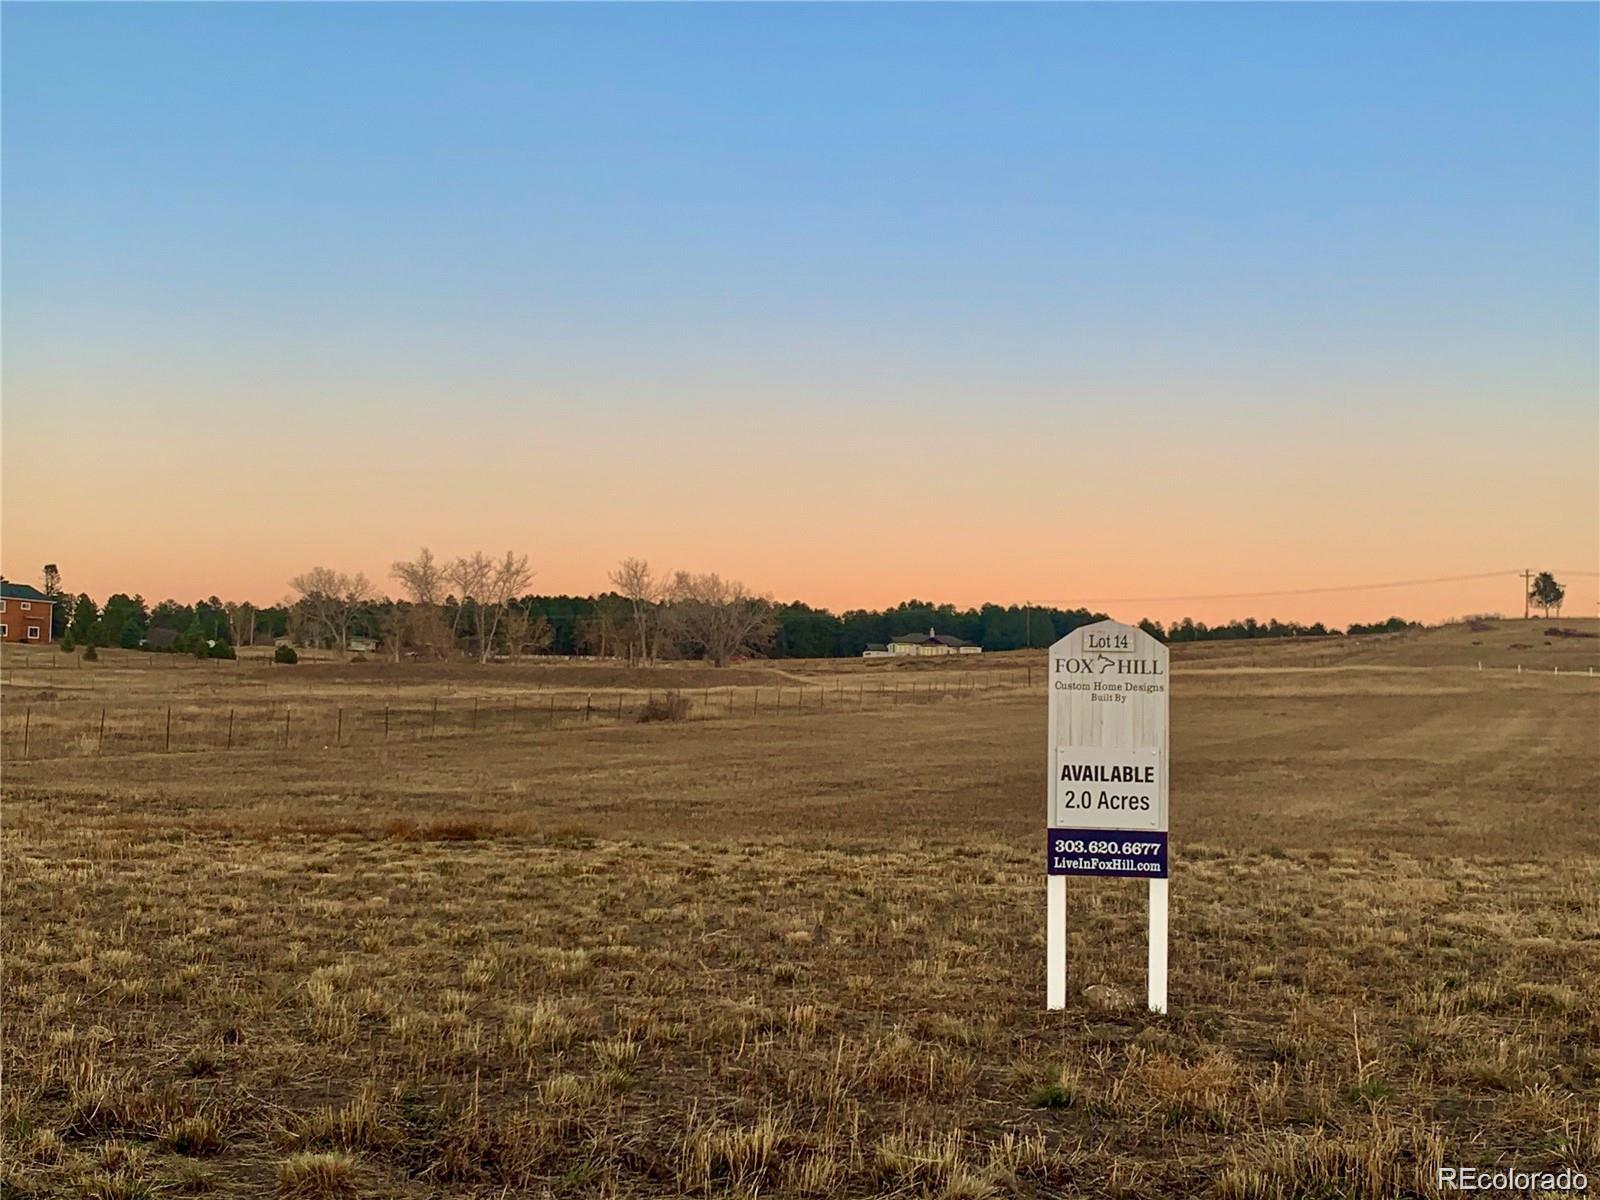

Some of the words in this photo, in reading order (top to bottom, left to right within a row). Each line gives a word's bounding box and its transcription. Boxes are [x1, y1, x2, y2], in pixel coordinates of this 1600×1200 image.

[1088, 634, 1111, 649] Lot
[1114, 634, 1128, 649] 14
[1055, 658, 1094, 674] FOX
[1117, 659, 1164, 675] HILL
[1054, 680, 1091, 691] Custom
[1093, 681, 1123, 692] Home
[1125, 682, 1165, 693] Designs
[1091, 693, 1113, 702] Built
[1114, 693, 1127, 704] By
[1060, 765, 1155, 783] AVAILABLE
[1065, 790, 1092, 809] 2.0
[1097, 791, 1150, 811] Acres
[1054, 839, 1161, 856] 303.620.6677
[1054, 857, 1161, 872] LiveInFoxHill.com
